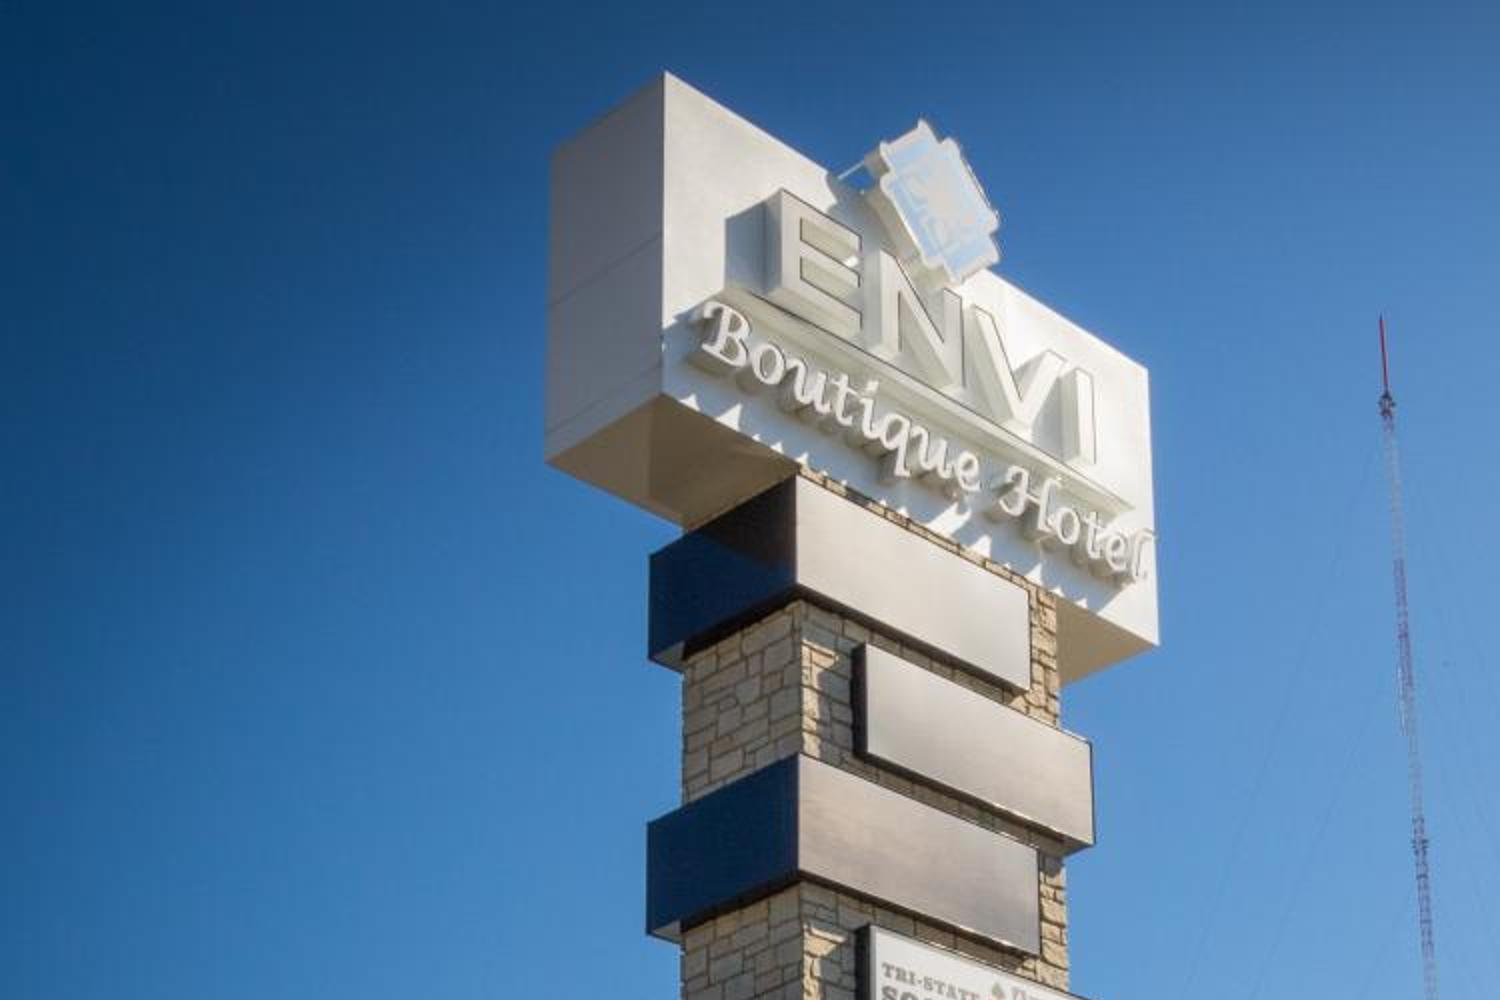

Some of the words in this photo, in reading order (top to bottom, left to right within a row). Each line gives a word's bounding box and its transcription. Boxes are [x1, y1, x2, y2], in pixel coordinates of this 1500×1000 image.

[699, 299, 982, 493] Boutique
[998, 463, 1157, 581] Hotel
[770, 187, 1098, 466] ENVI
